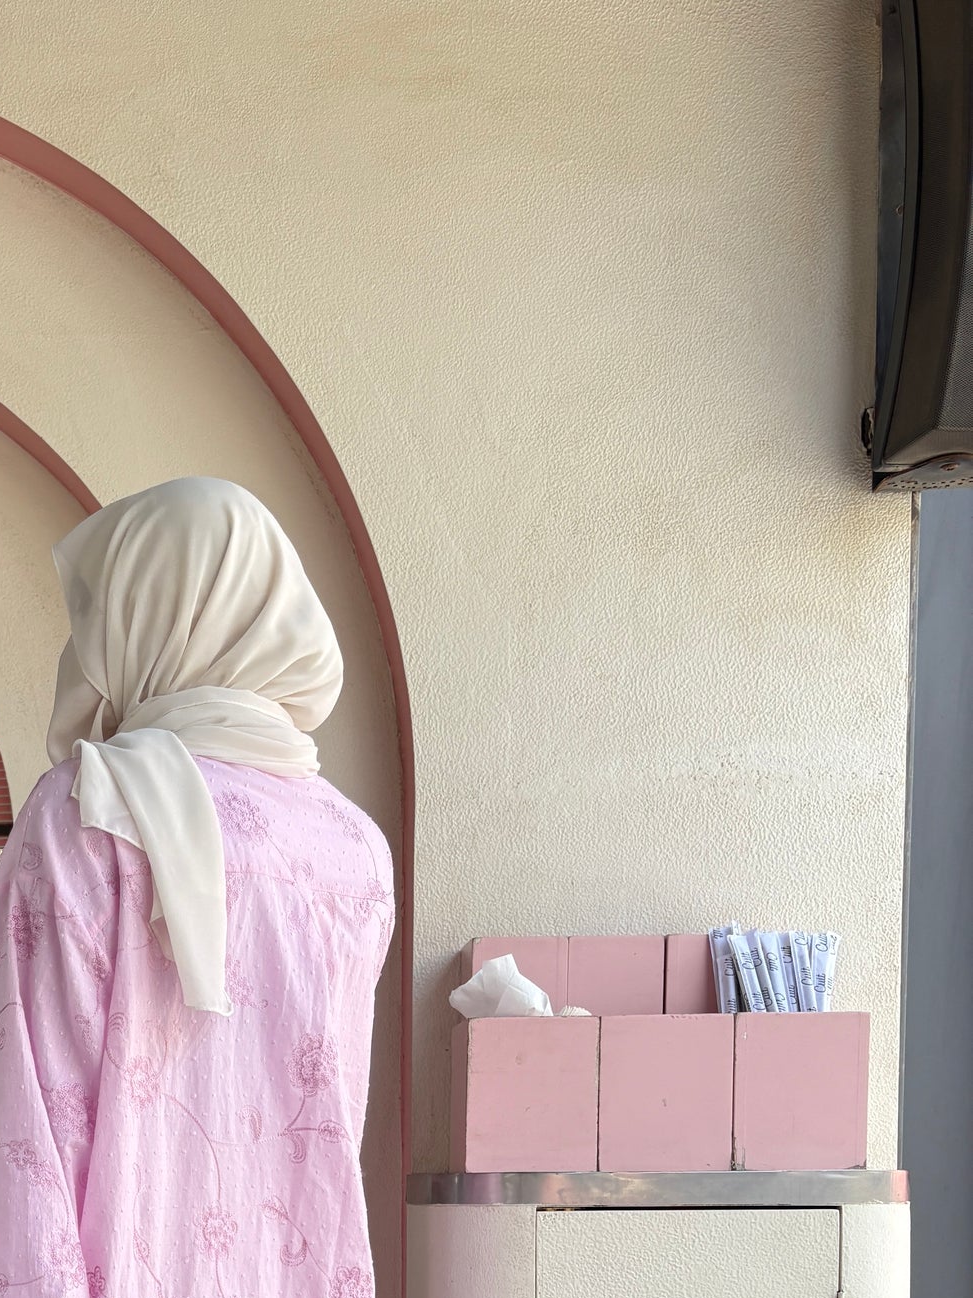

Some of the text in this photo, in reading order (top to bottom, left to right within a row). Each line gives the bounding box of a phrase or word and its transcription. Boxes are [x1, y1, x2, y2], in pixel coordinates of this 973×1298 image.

[724, 957, 734, 976] Cult
[741, 952, 754, 970] Cult
[750, 948, 762, 968] Cult
[766, 952, 778, 972] Cult
[800, 967, 813, 986] Cult
[814, 973, 826, 993] Cult
[752, 993, 766, 1011] Cult
[762, 987, 772, 1007] Cult
[774, 993, 786, 1013] Cult
